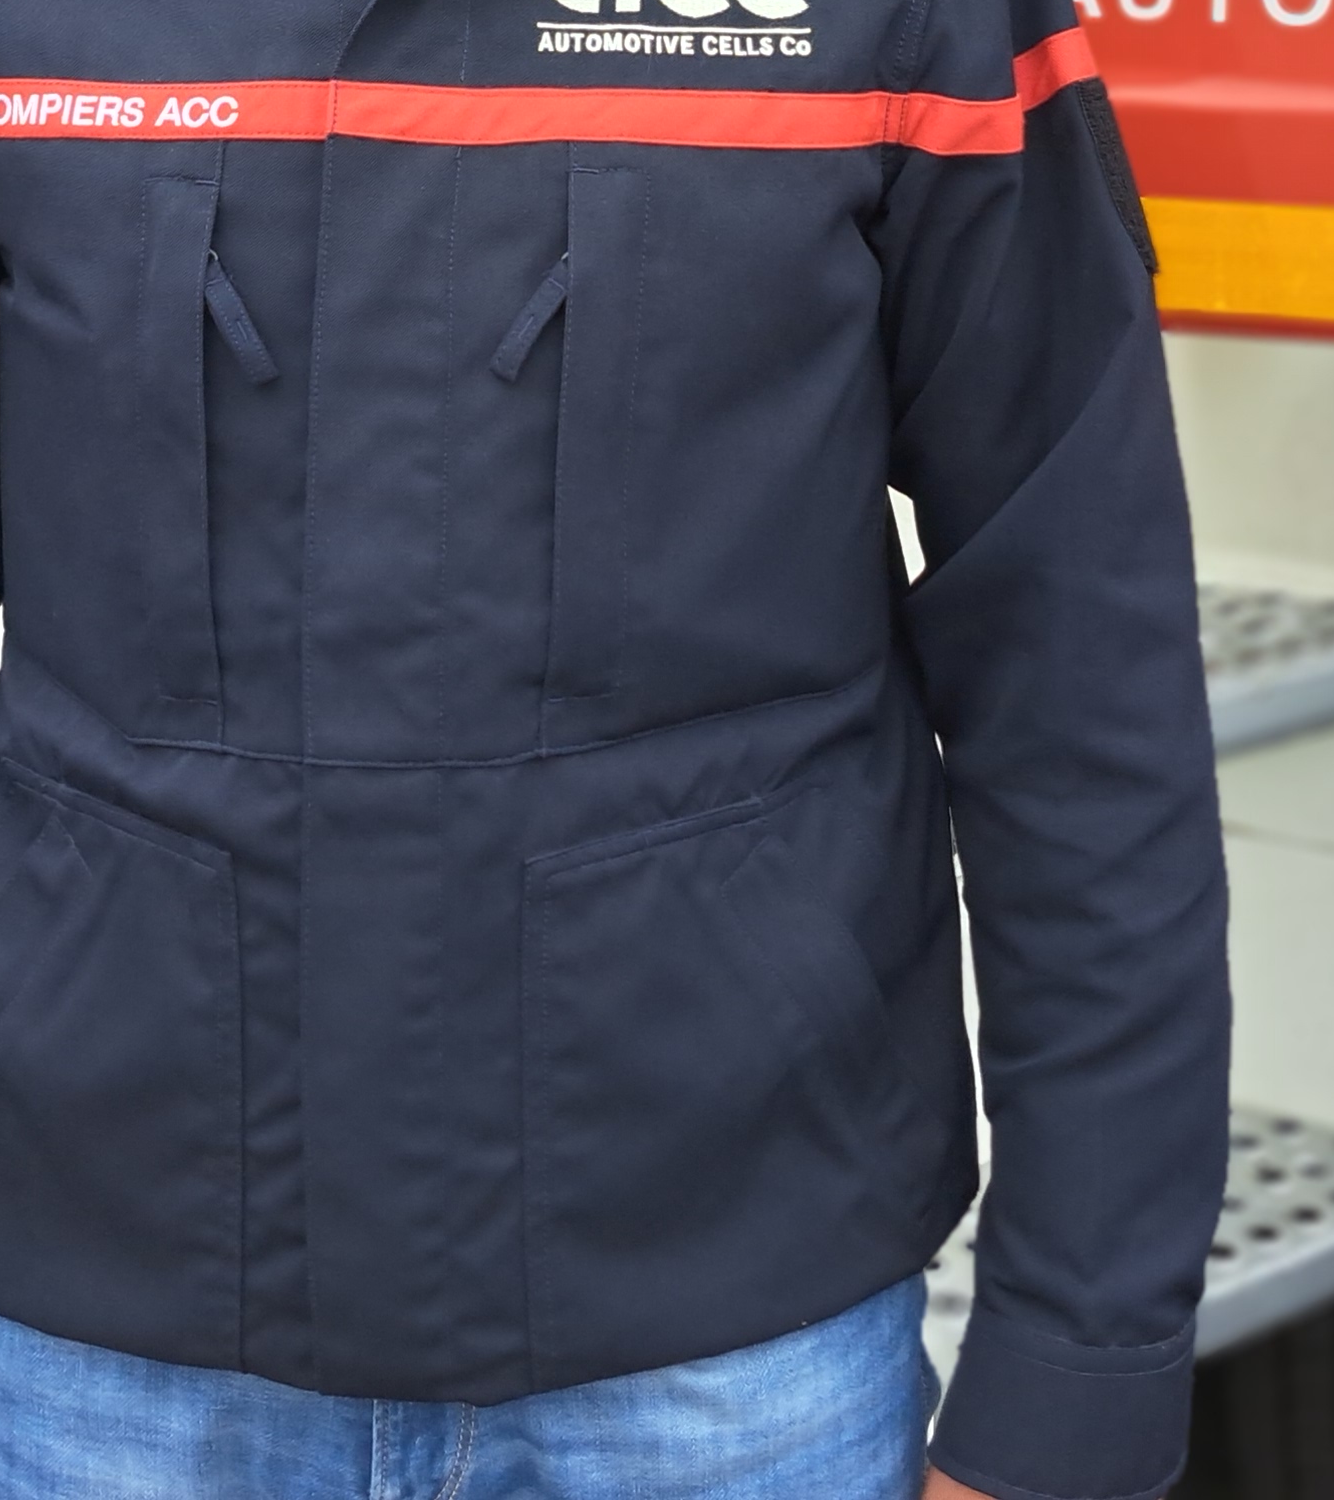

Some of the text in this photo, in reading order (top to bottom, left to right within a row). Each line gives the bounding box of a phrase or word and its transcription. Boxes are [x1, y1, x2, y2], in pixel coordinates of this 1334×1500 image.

[537, 31, 812, 57] AUTOMOTIVE CELLS Co
[155, 97, 239, 127] ACC
